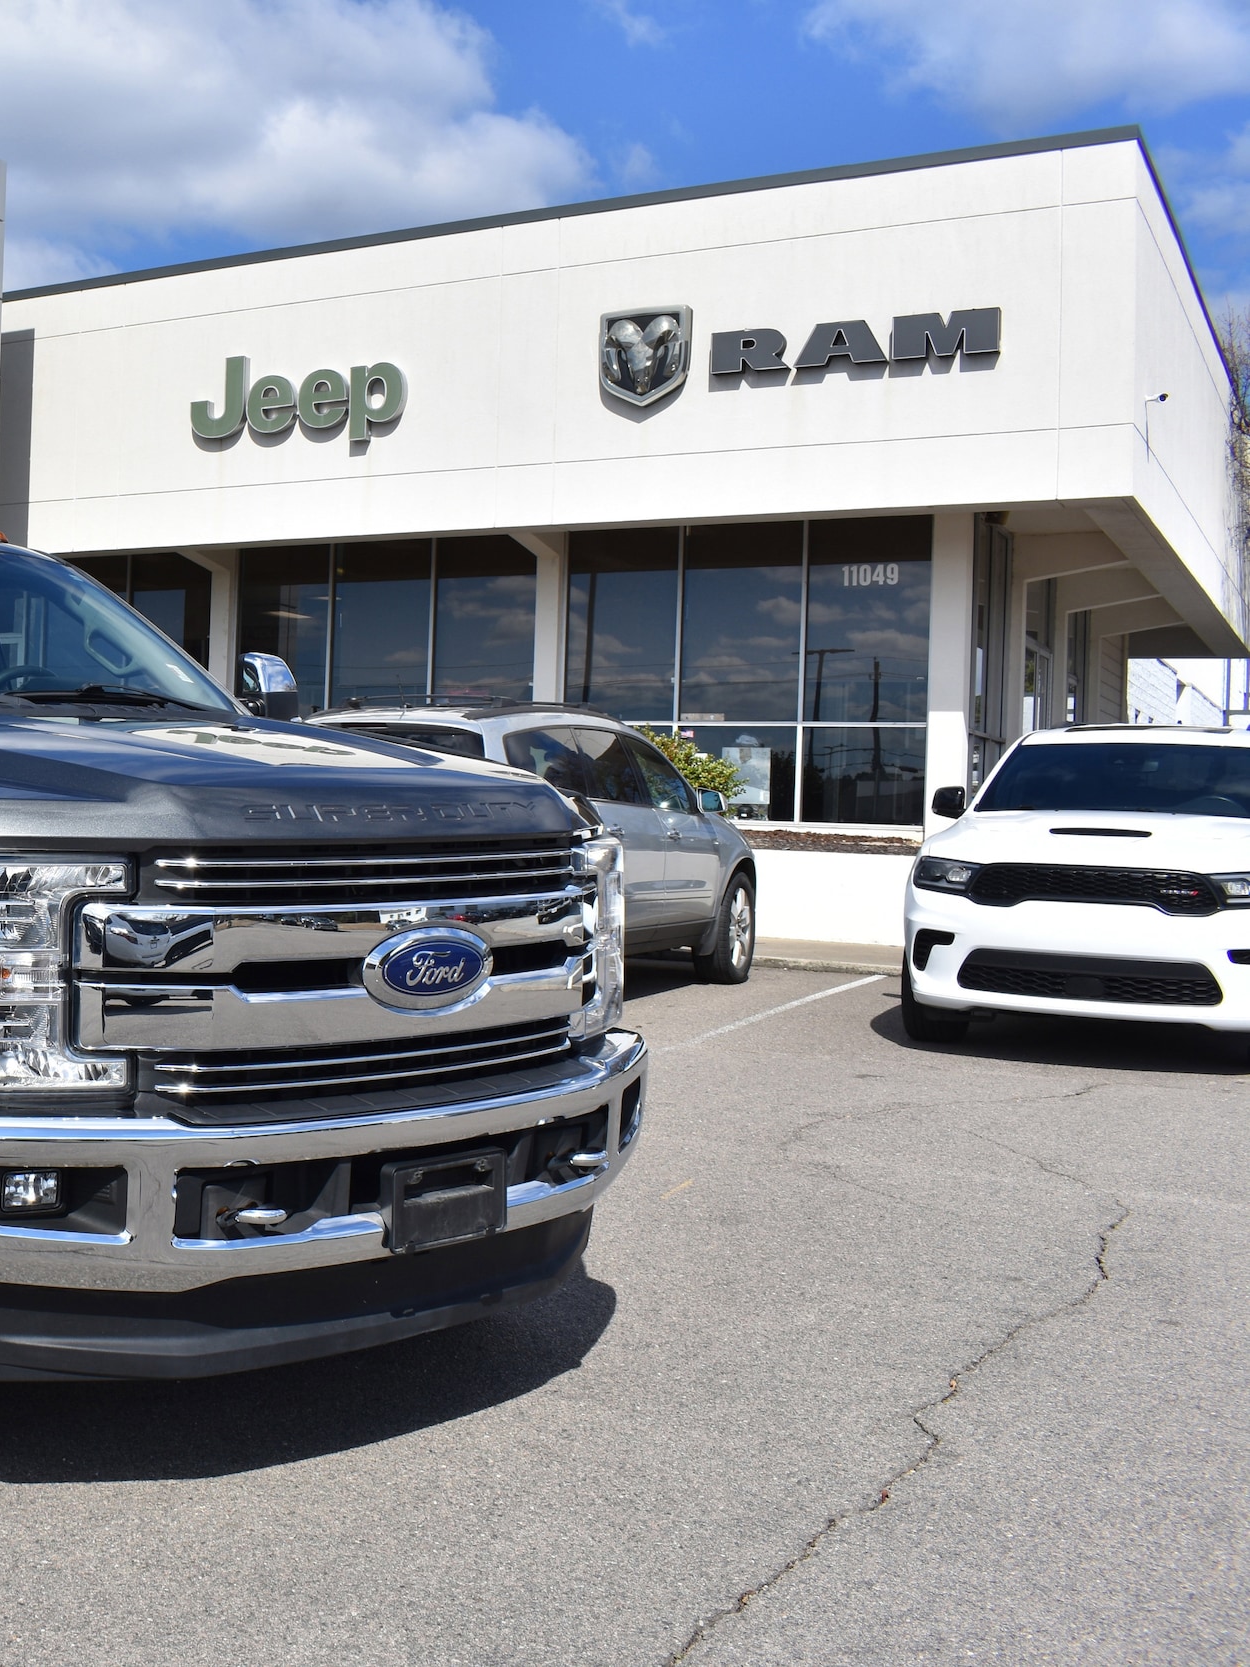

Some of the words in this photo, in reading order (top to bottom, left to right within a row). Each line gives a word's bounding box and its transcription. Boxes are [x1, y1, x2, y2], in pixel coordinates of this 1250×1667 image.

[710, 306, 1002, 376] RAM
[190, 355, 409, 441] Jeep
[841, 563, 899, 587] 11049
[242, 804, 427, 823] SUPER
[430, 801, 537, 821] DUTY
[405, 950, 466, 987] Ford
